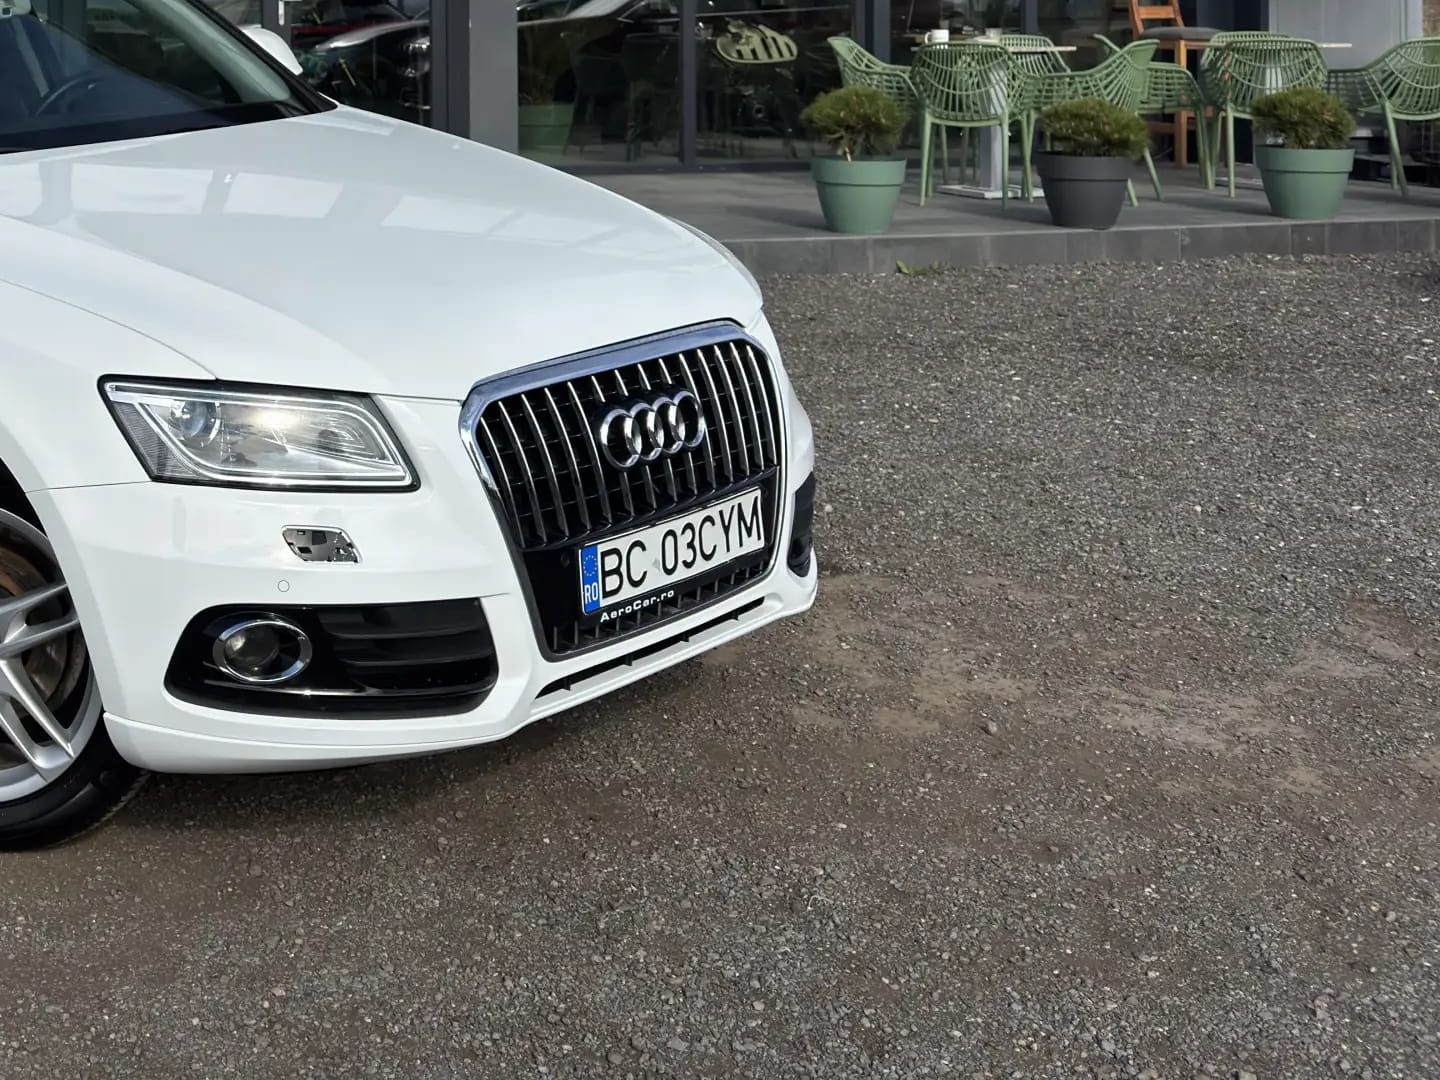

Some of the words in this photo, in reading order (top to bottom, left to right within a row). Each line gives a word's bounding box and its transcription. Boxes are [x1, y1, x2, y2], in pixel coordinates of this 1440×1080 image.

[600, 539, 648, 599] BC
[661, 495, 762, 576] 03CYM
[584, 582, 599, 605] RO
[600, 589, 675, 622] AeroCar.ro
